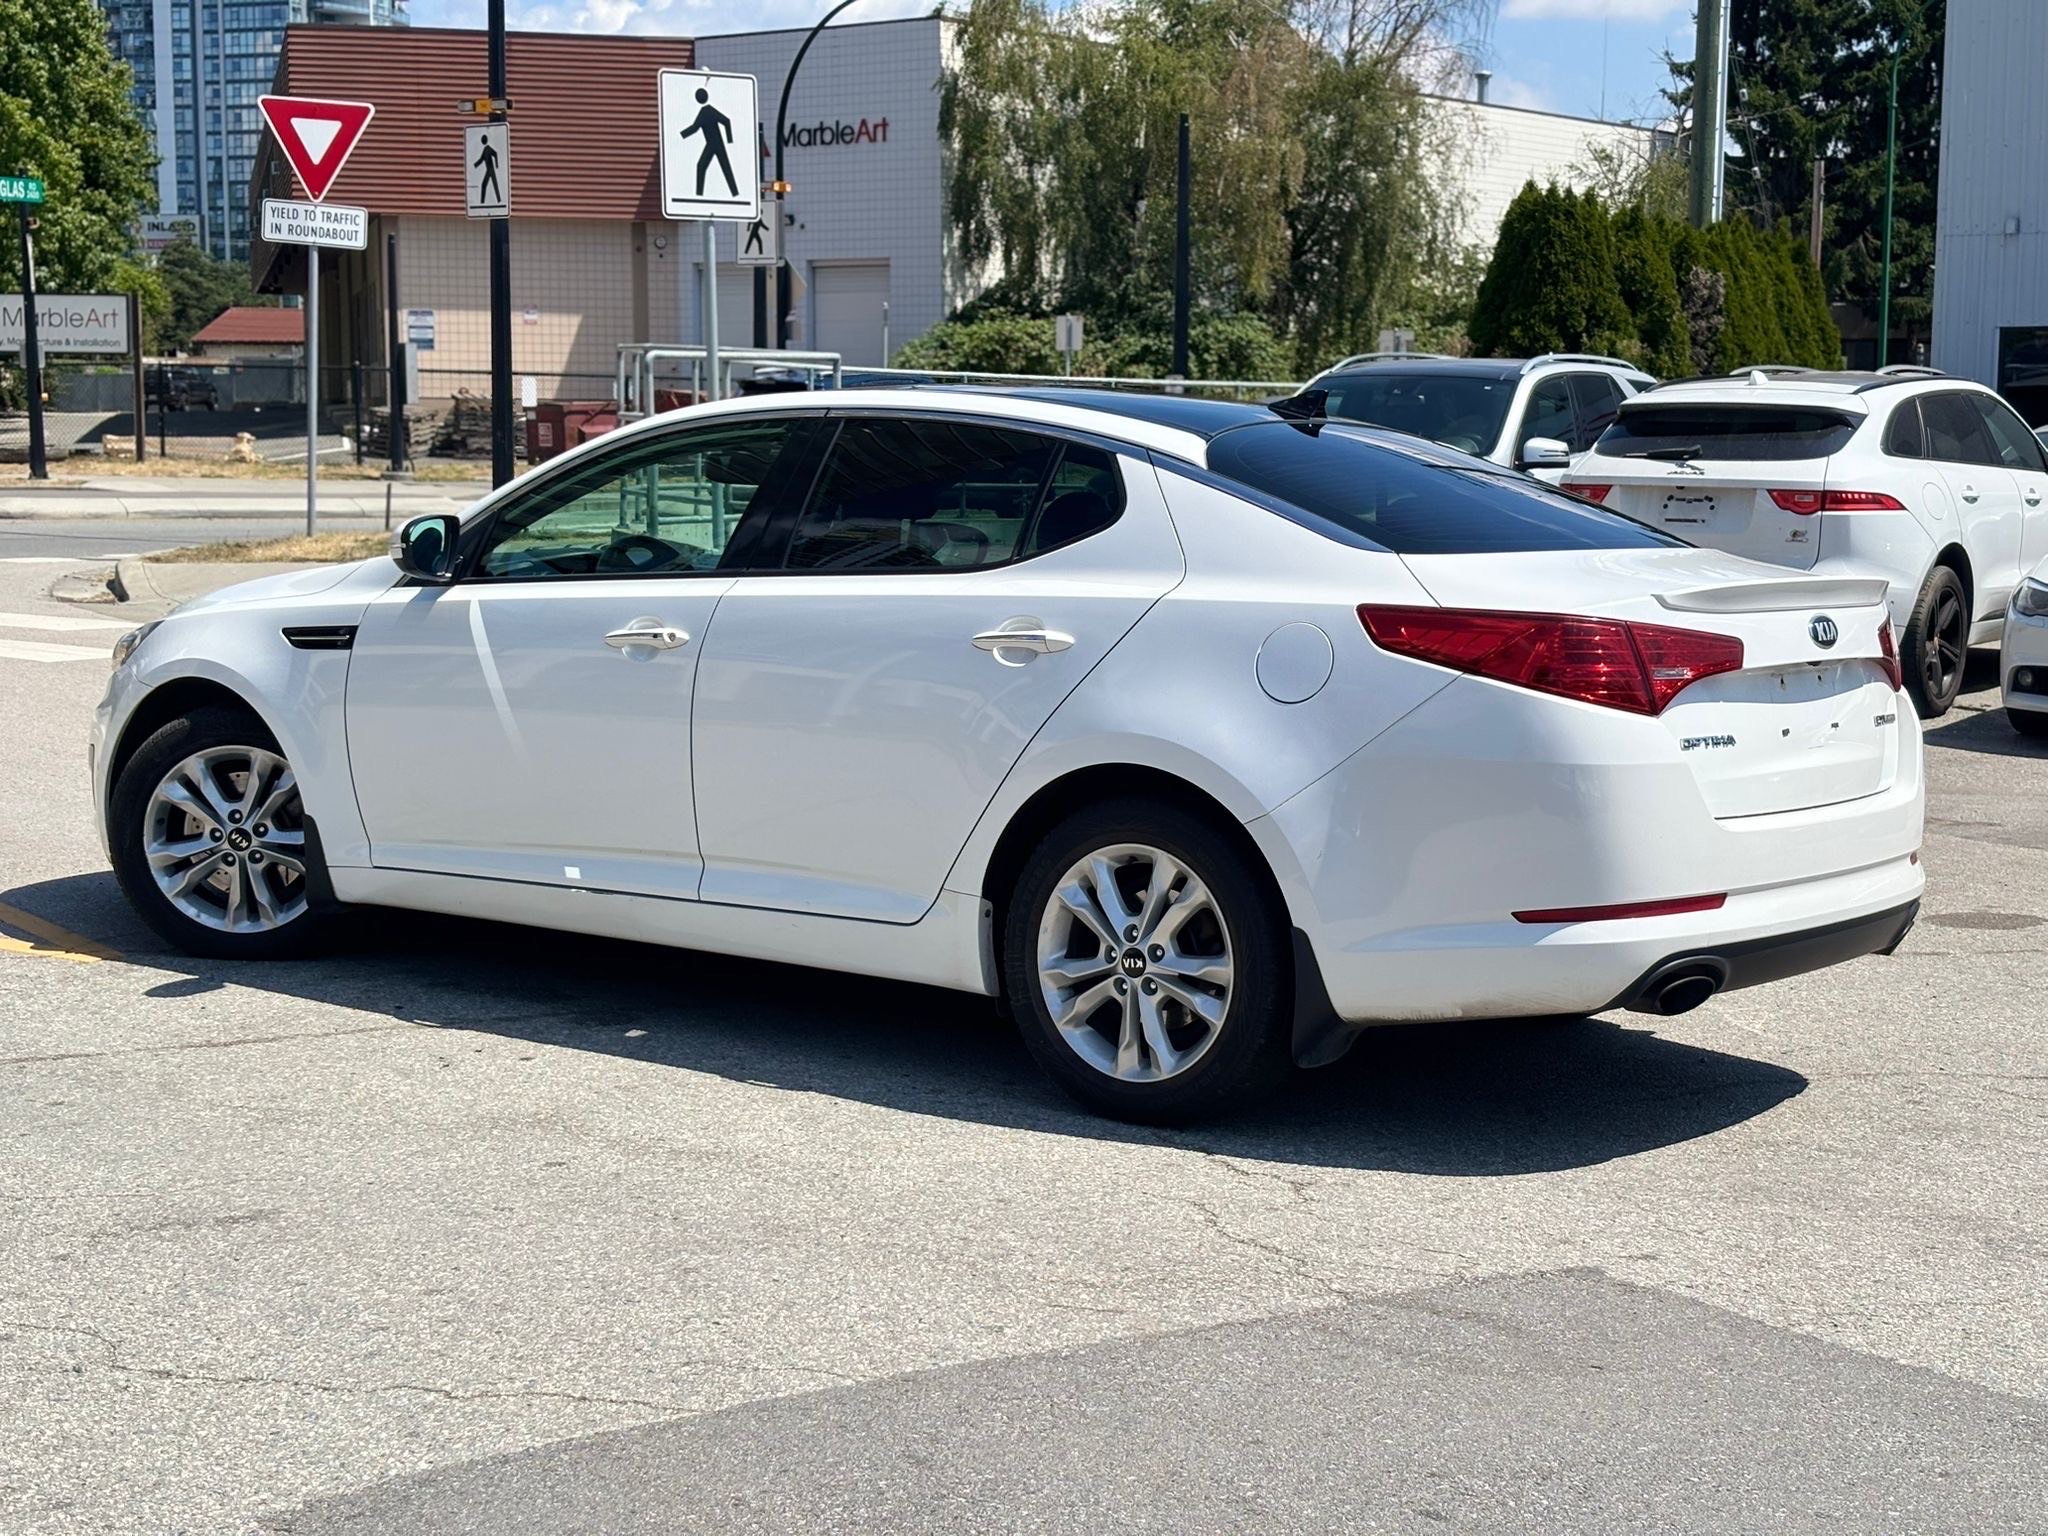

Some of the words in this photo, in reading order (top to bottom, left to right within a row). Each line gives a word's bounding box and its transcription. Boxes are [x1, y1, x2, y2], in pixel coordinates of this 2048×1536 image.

[783, 117, 889, 147] MarbleArt
[271, 206, 299, 220] YIELD
[304, 209, 316, 222] TO
[321, 211, 360, 227] TRAFFIC
[147, 221, 196, 232] INLAD
[270, 223, 281, 234] IN
[287, 223, 359, 242] ROUNDABOUT
[1814, 621, 1837, 641] KIA
[1680, 734, 1736, 751] OPTIMA
[1122, 958, 1144, 969] KIA
